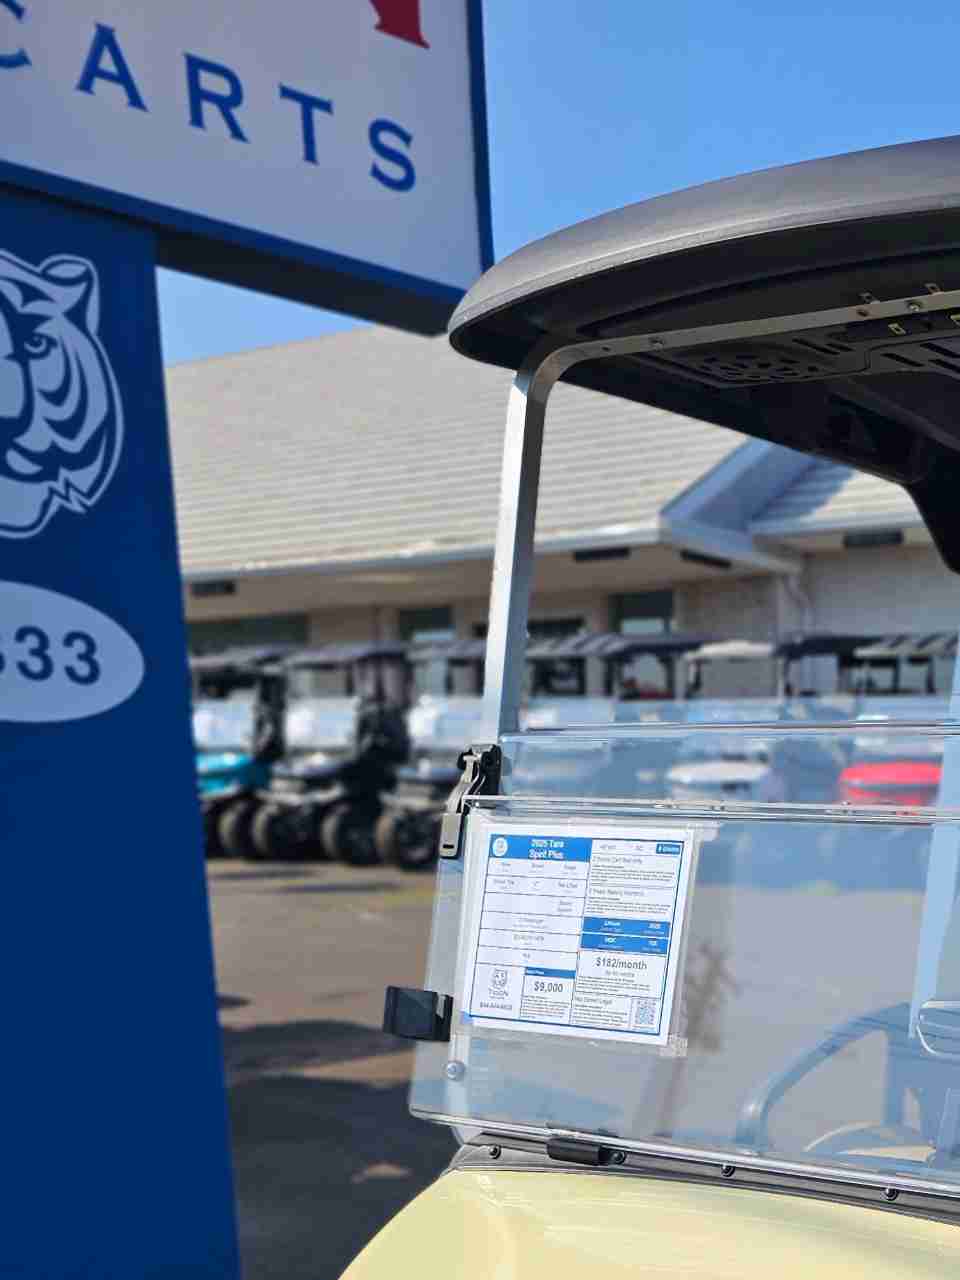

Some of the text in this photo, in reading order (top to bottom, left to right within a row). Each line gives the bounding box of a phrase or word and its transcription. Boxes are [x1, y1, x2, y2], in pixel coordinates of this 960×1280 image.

[0, 624, 102, 686] 33
[596, 956, 648, 970] $182/month
[534, 980, 564, 993] $9,000
